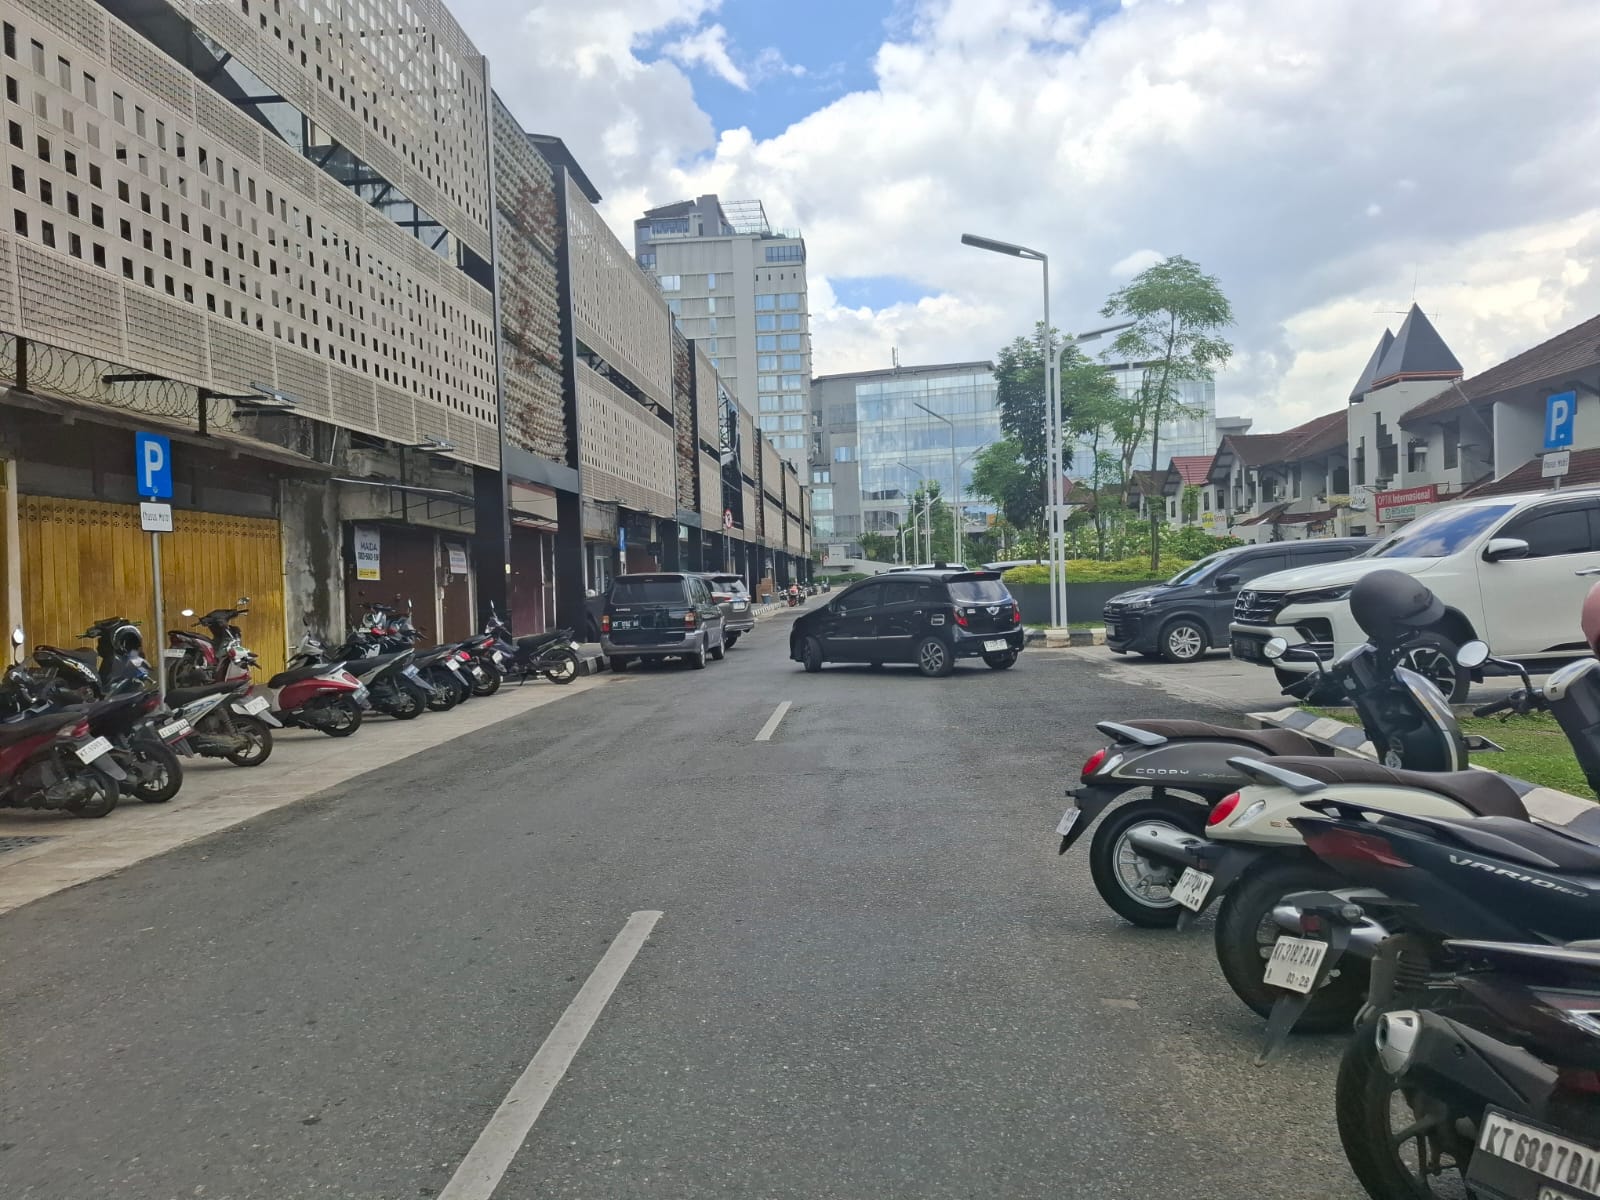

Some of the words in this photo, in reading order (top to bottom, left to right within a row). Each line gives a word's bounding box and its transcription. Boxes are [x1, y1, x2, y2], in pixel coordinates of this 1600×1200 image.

[1551, 400, 1569, 441] P
[144, 440, 164, 488] P
[1485, 1123, 1514, 1158] KT
